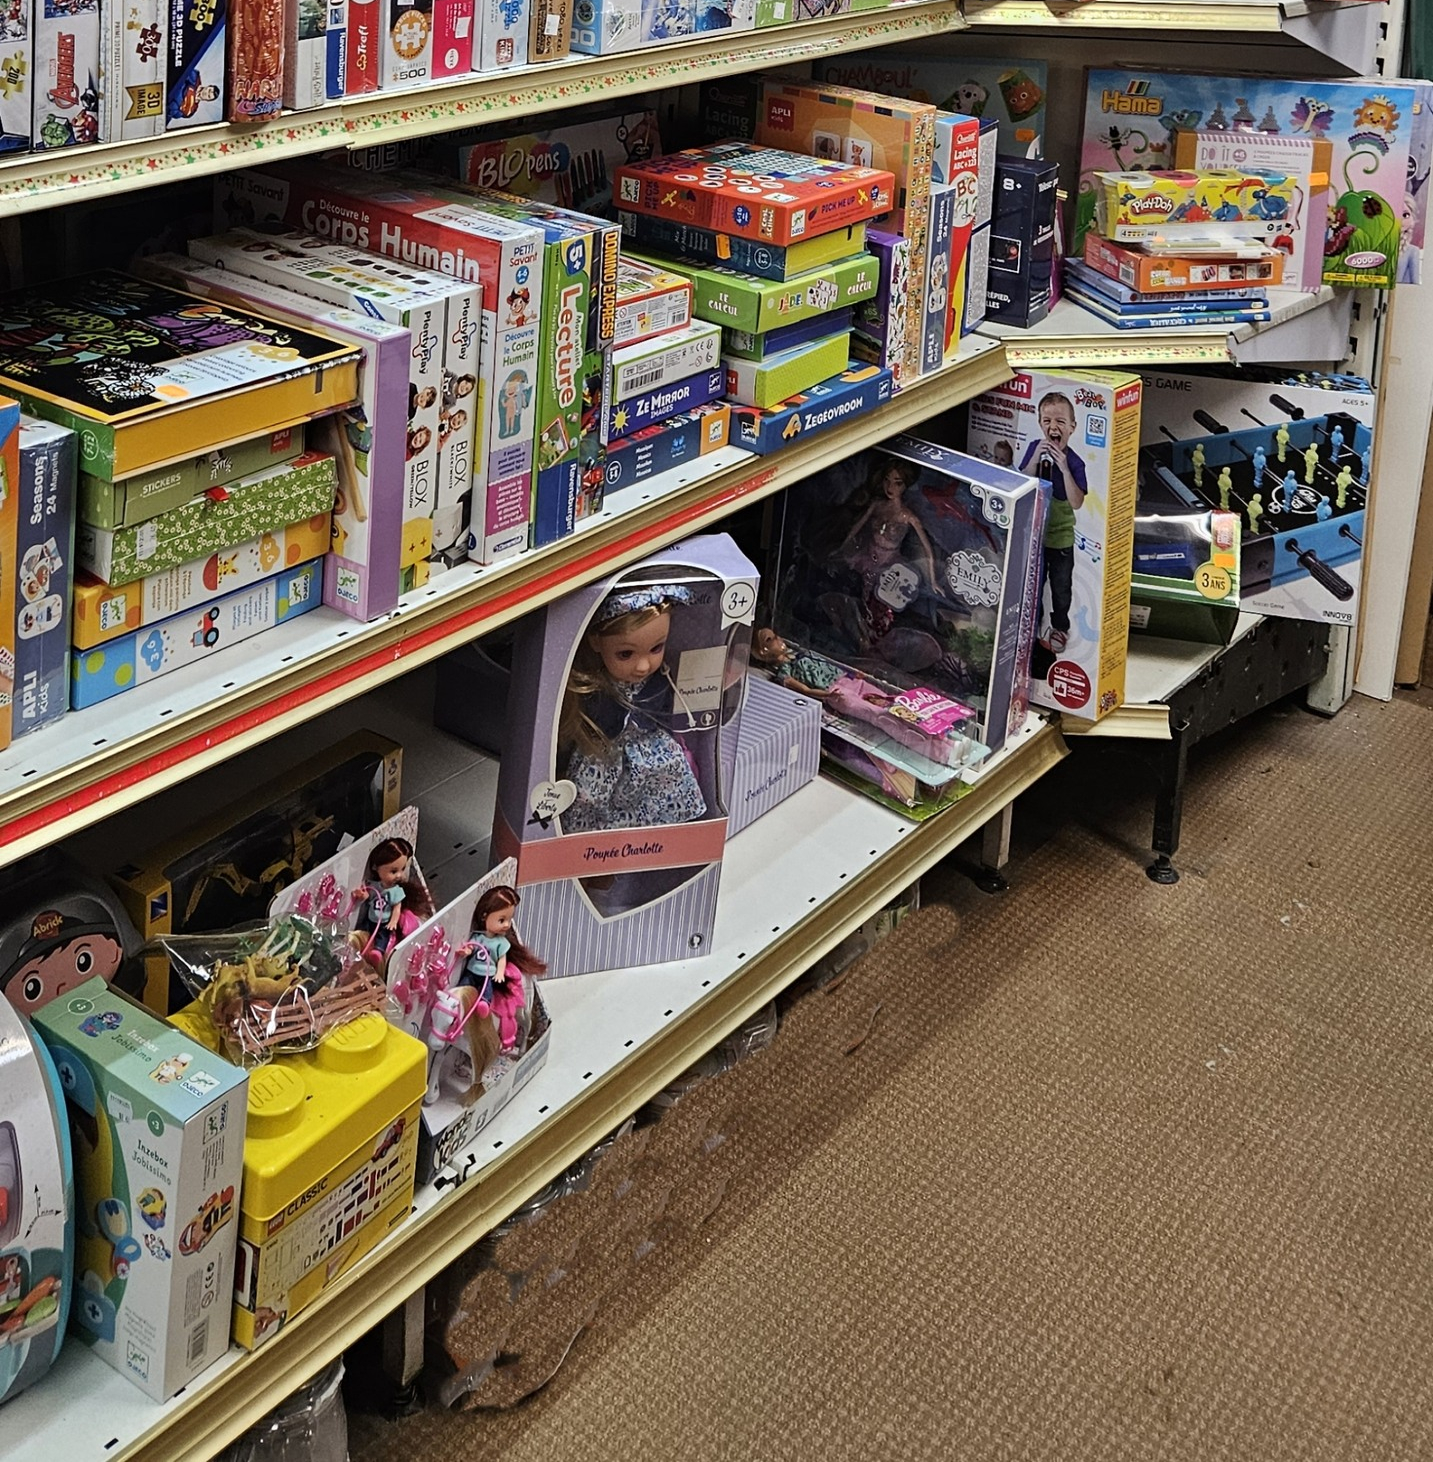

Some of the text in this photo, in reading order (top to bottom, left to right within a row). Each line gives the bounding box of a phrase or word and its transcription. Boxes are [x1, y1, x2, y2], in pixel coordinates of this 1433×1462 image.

[141, 31, 156, 54] 300
[175, 29, 184, 67] PUZZLE
[336, 31, 347, 91] Ravensburger
[400, 68, 427, 82] 500
[136, 89, 147, 115] IMAGE
[147, 91, 161, 109] 3D
[771, 105, 792, 117] APLI
[1102, 89, 1164, 116] Hama
[705, 110, 750, 133] Lacing
[954, 146, 978, 161] Lacing
[250, 182, 285, 202] Savant
[319, 198, 359, 221] Découvre
[821, 202, 836, 214] PICK
[1132, 196, 1173, 218] Play-Doh
[302, 199, 480, 283] Corps Humain
[513, 243, 535, 257] PETIT
[509, 252, 538, 267] Savant
[569, 242, 583, 270] 5+
[600, 231, 619, 339] DOMINO EXPRESS
[856, 271, 865, 282] LE
[719, 292, 730, 303] LE
[847, 281, 872, 297] CALCUL
[708, 301, 738, 317] CALCUL
[458, 297, 471, 361] PlentyPlay
[504, 328, 535, 343] Découvre
[418, 310, 432, 375] PlentyPlay
[511, 339, 535, 352] Corps
[559, 284, 581, 408] Lecture
[502, 350, 535, 367] Humain
[1155, 376, 1193, 393] GAME
[1116, 389, 1139, 407] winfun
[1341, 396, 1358, 407] AGES
[650, 403, 674, 419] IMAGES
[453, 440, 468, 488] BLOX
[30, 456, 45, 525] Seasons
[46, 451, 60, 514] 24 Magnets
[143, 472, 182, 494] STICKERS
[414, 459, 429, 508] BLOX
[565, 463, 577, 531] Ravensburger
[956, 567, 989, 588] EMILY
[1210, 578, 1226, 591] ANS
[337, 588, 359, 602] DJECO
[728, 591, 749, 609] 3+
[1054, 666, 1069, 676] CPS
[22, 669, 39, 719] APLI
[898, 689, 942, 711] Barbie
[583, 841, 664, 863] Poupée Charlotte
[33, 914, 64, 938] Abrick
[111, 1033, 152, 1063] Jobissimo
[126, 1029, 160, 1052] Inzebox
[248, 1068, 294, 1109] LEGO
[137, 1139, 169, 1169] Inzebox
[132, 1151, 172, 1186] Jobissimo
[286, 1178, 329, 1217] CLASSIC
[127, 1360, 148, 1380] DJECO
